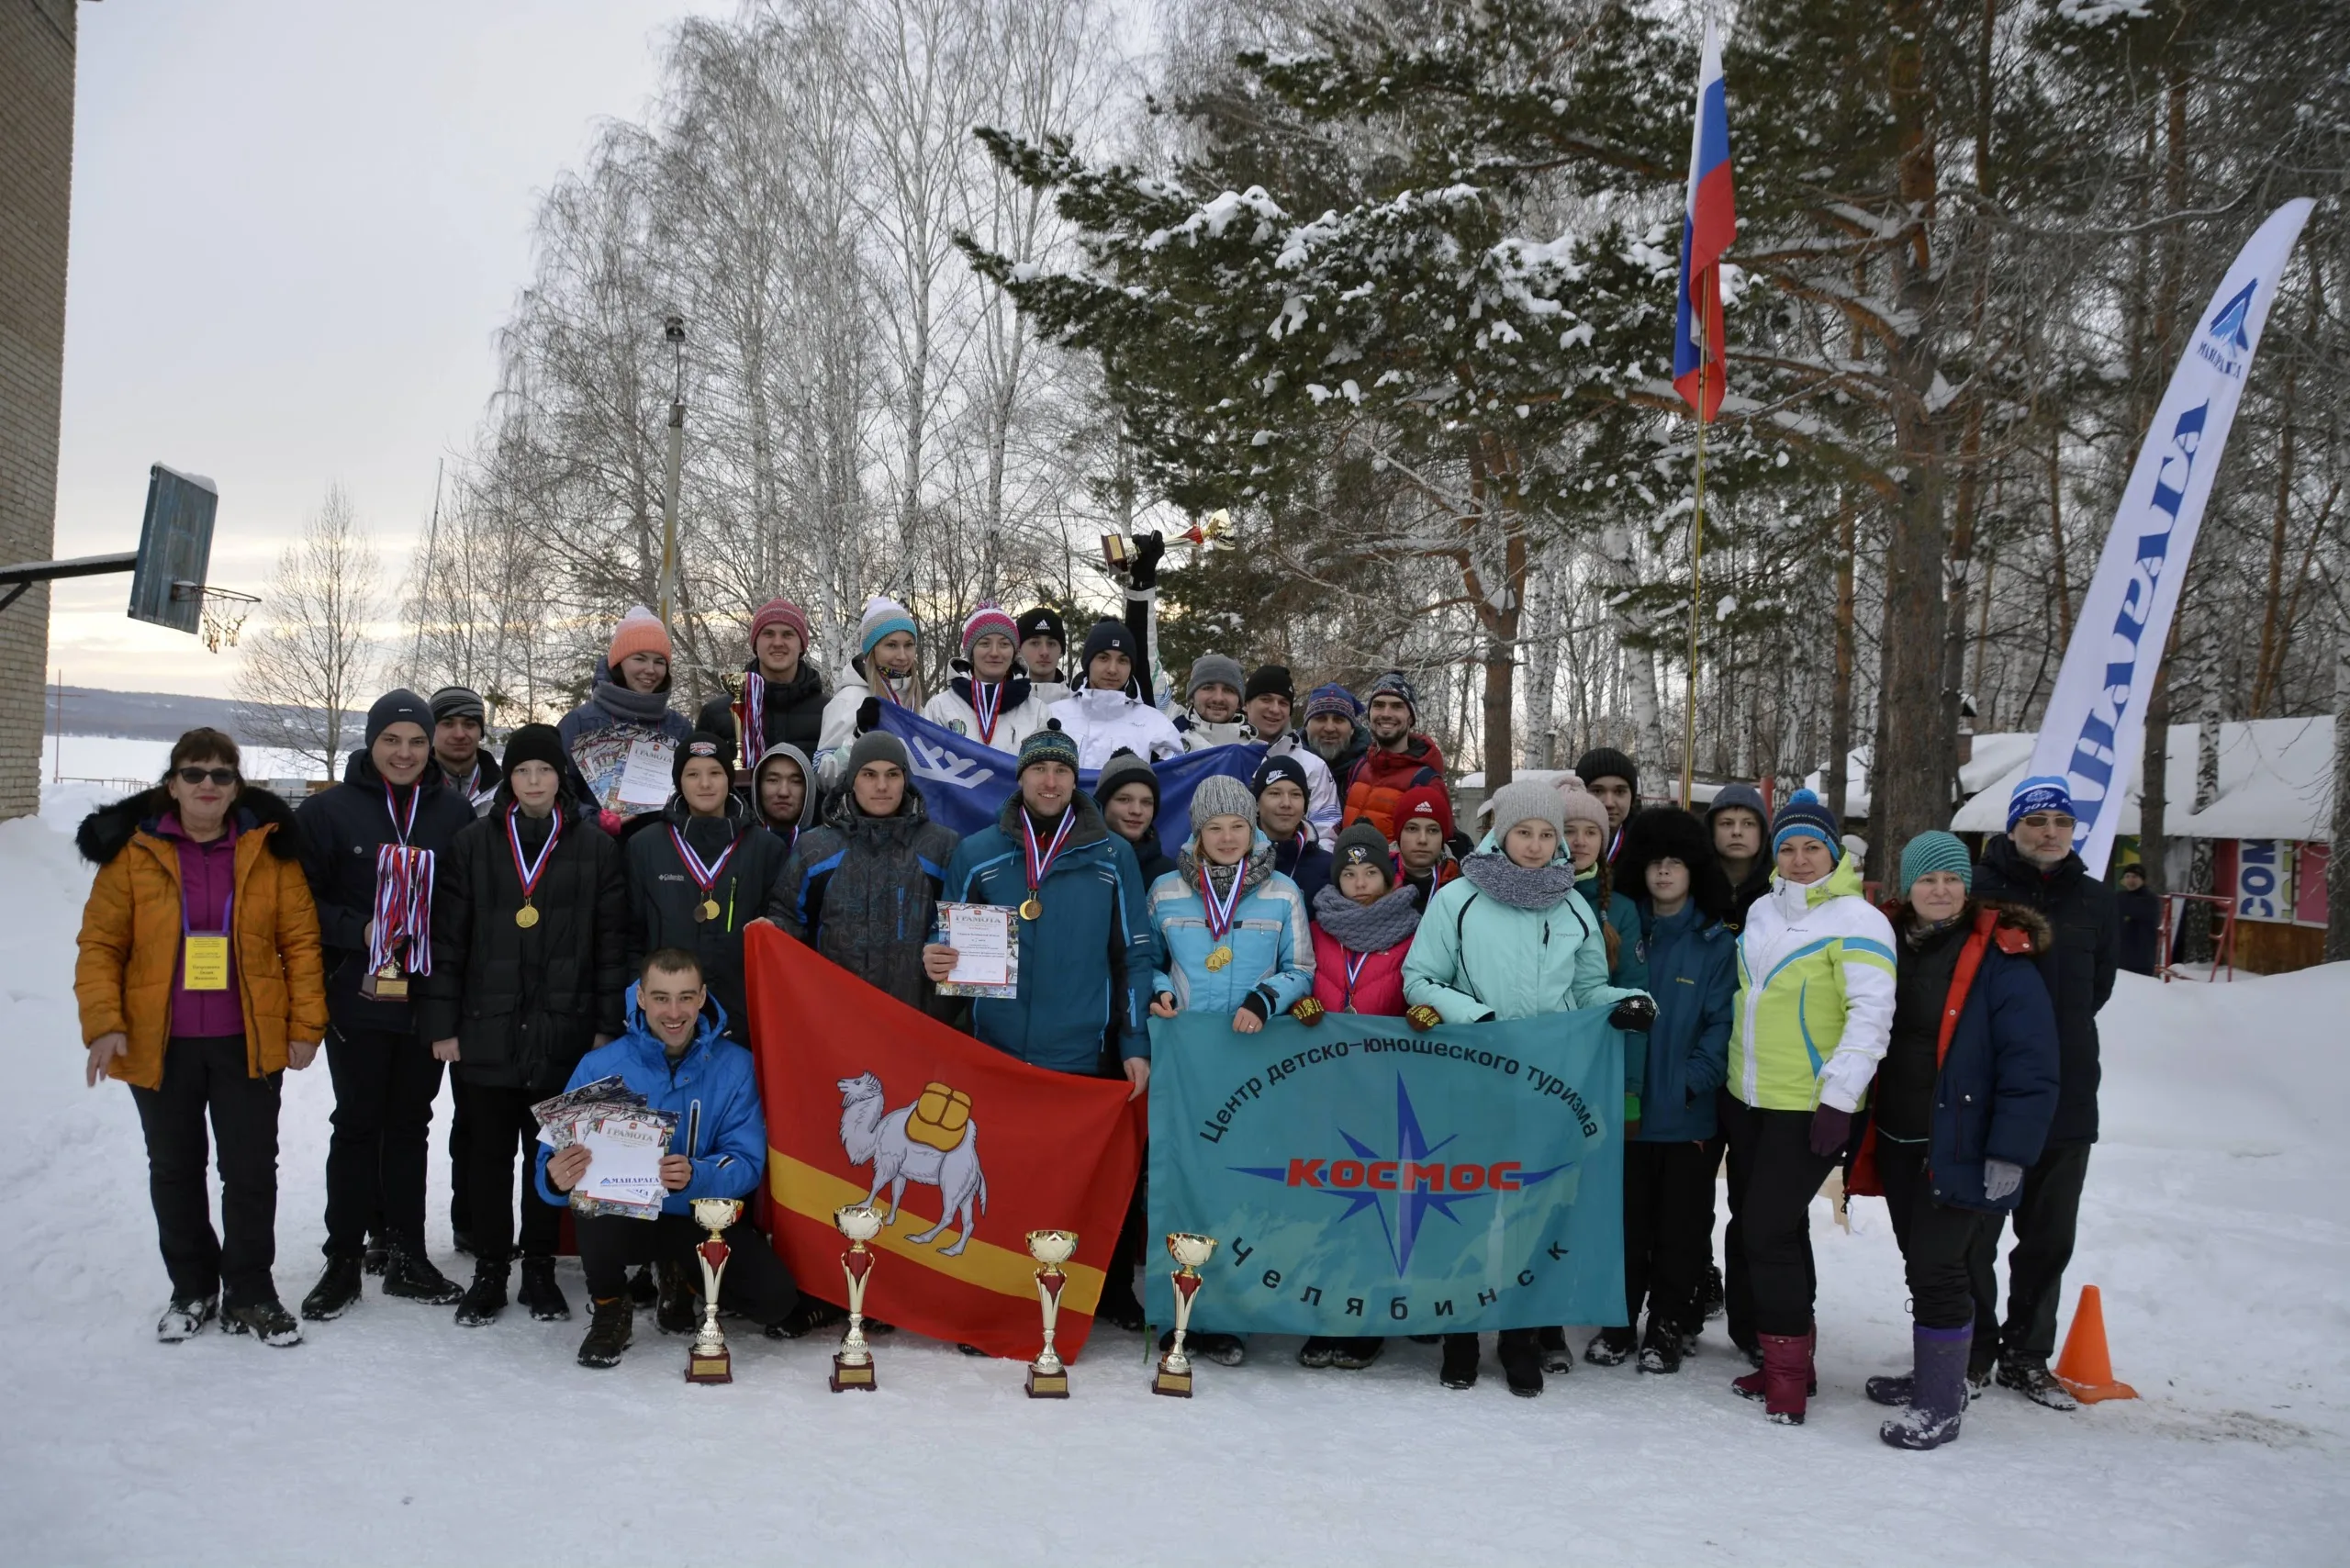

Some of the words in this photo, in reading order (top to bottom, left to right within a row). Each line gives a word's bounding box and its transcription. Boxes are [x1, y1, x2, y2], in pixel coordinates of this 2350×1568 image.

[2071, 397, 2210, 856] АНАРАГА
[955, 914, 1002, 924] ГРАМОТА
[1199, 1077, 1263, 1144] Центр
[1266, 1037, 1520, 1086] детско-юношеского
[1527, 1065, 1598, 1138] туризма
[607, 1127, 654, 1142] ГРАМОТА
[1286, 1159, 1521, 1192] КОСМОС
[1231, 1236, 1570, 1321] Челябинск
